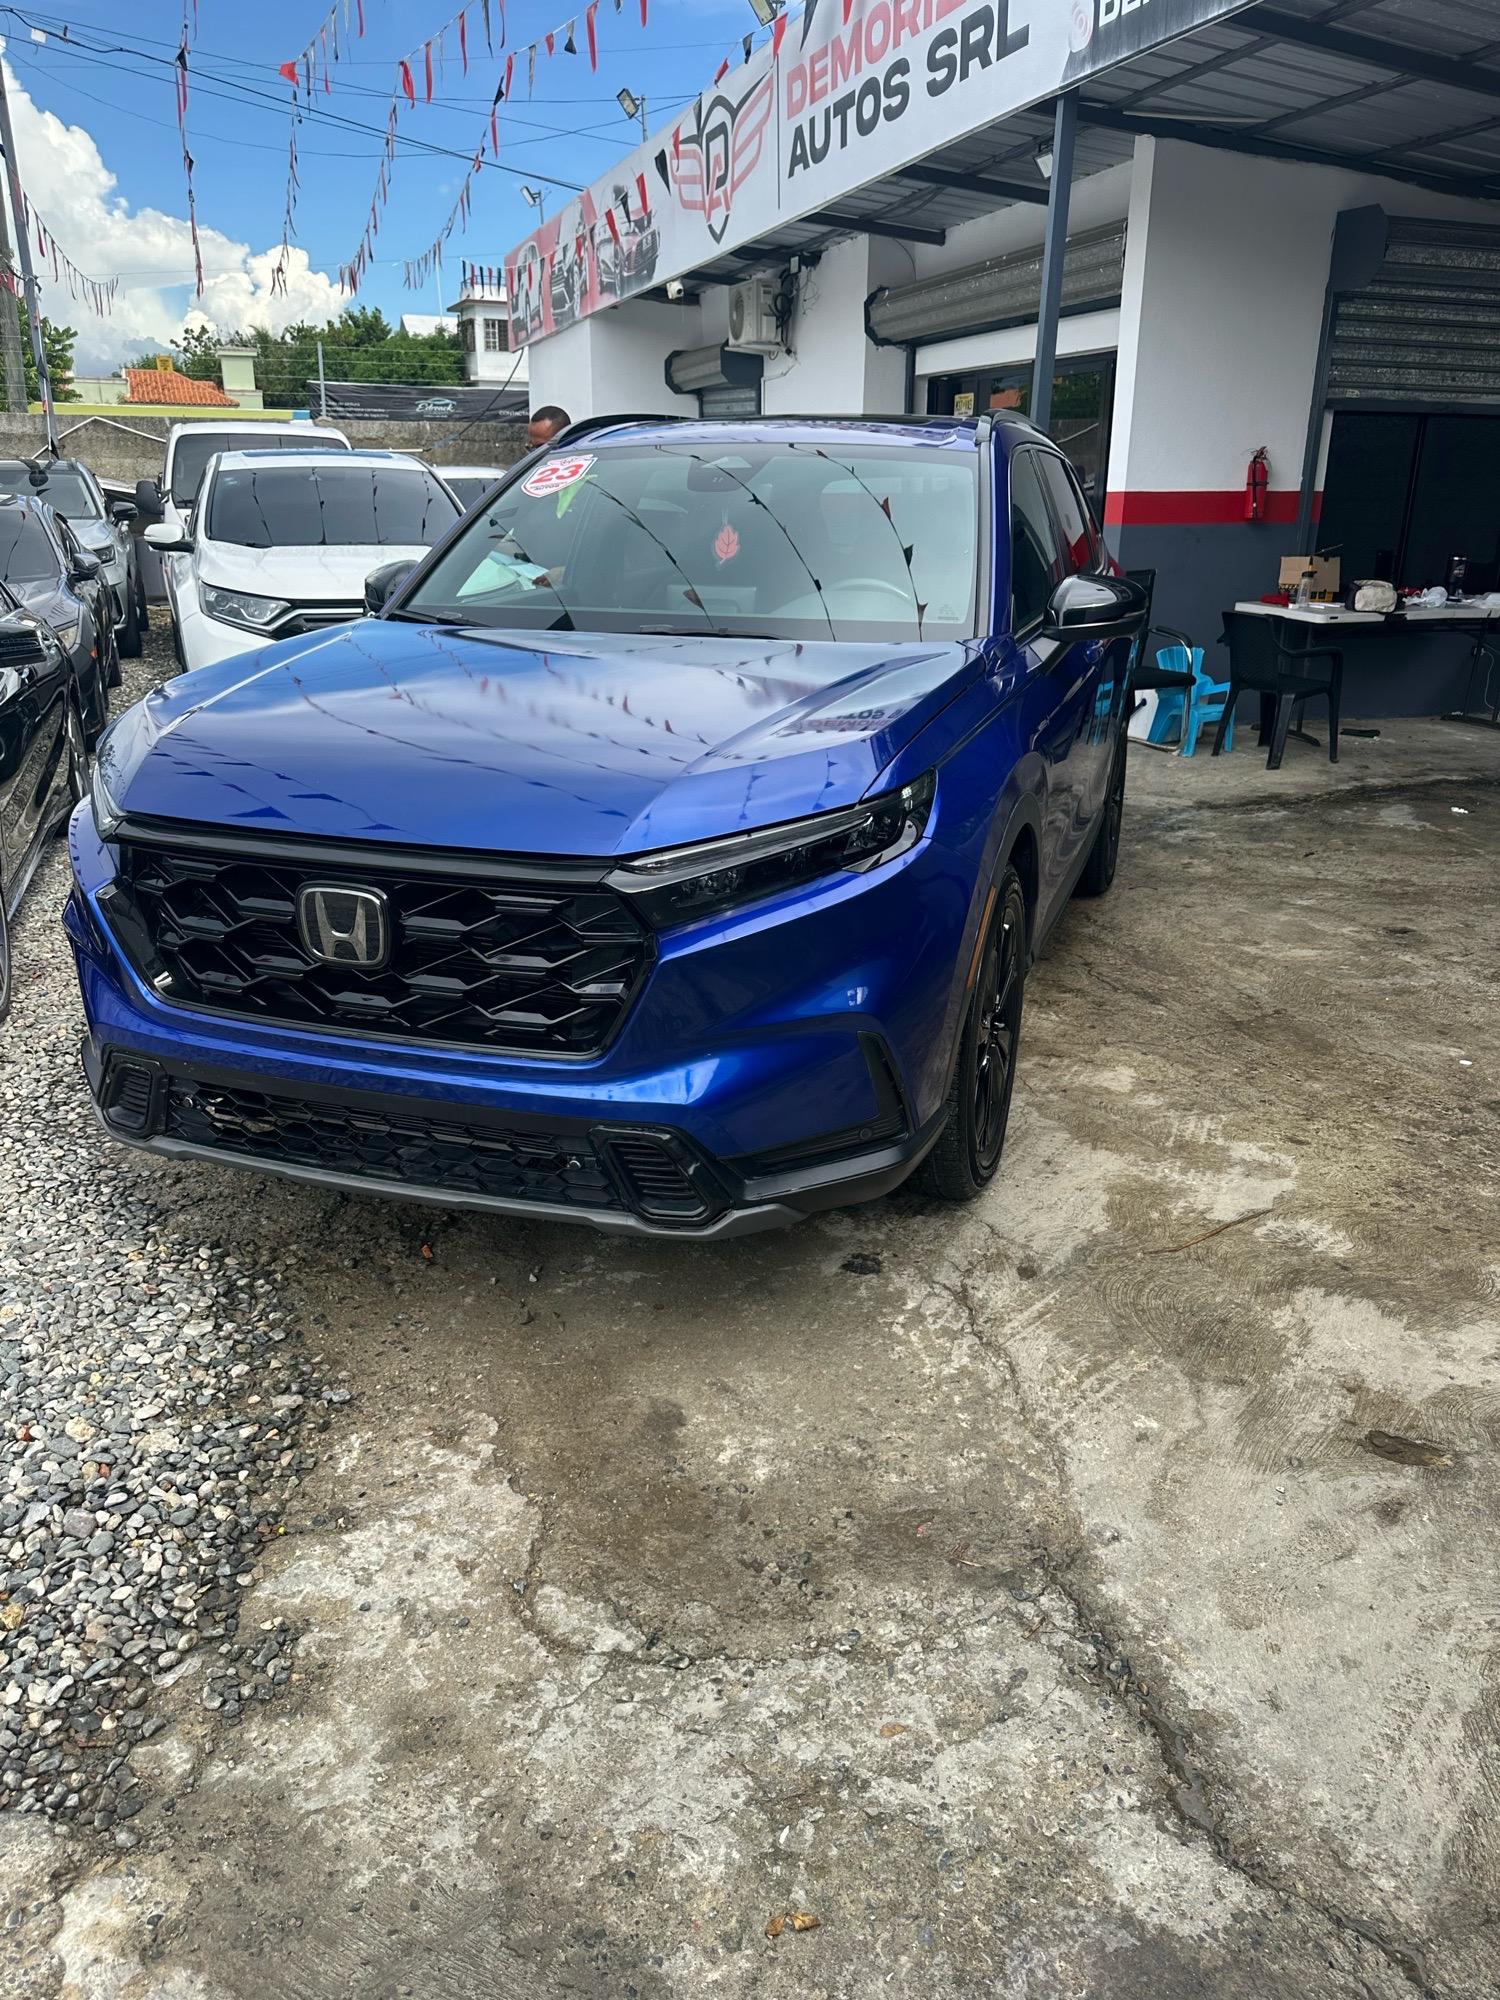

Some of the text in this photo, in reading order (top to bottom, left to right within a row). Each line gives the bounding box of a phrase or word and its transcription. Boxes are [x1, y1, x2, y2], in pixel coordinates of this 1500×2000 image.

[787, 0, 967, 120] DEMORI
[788, 0, 1030, 179] AUTOS SRL
[529, 464, 584, 485] 23
